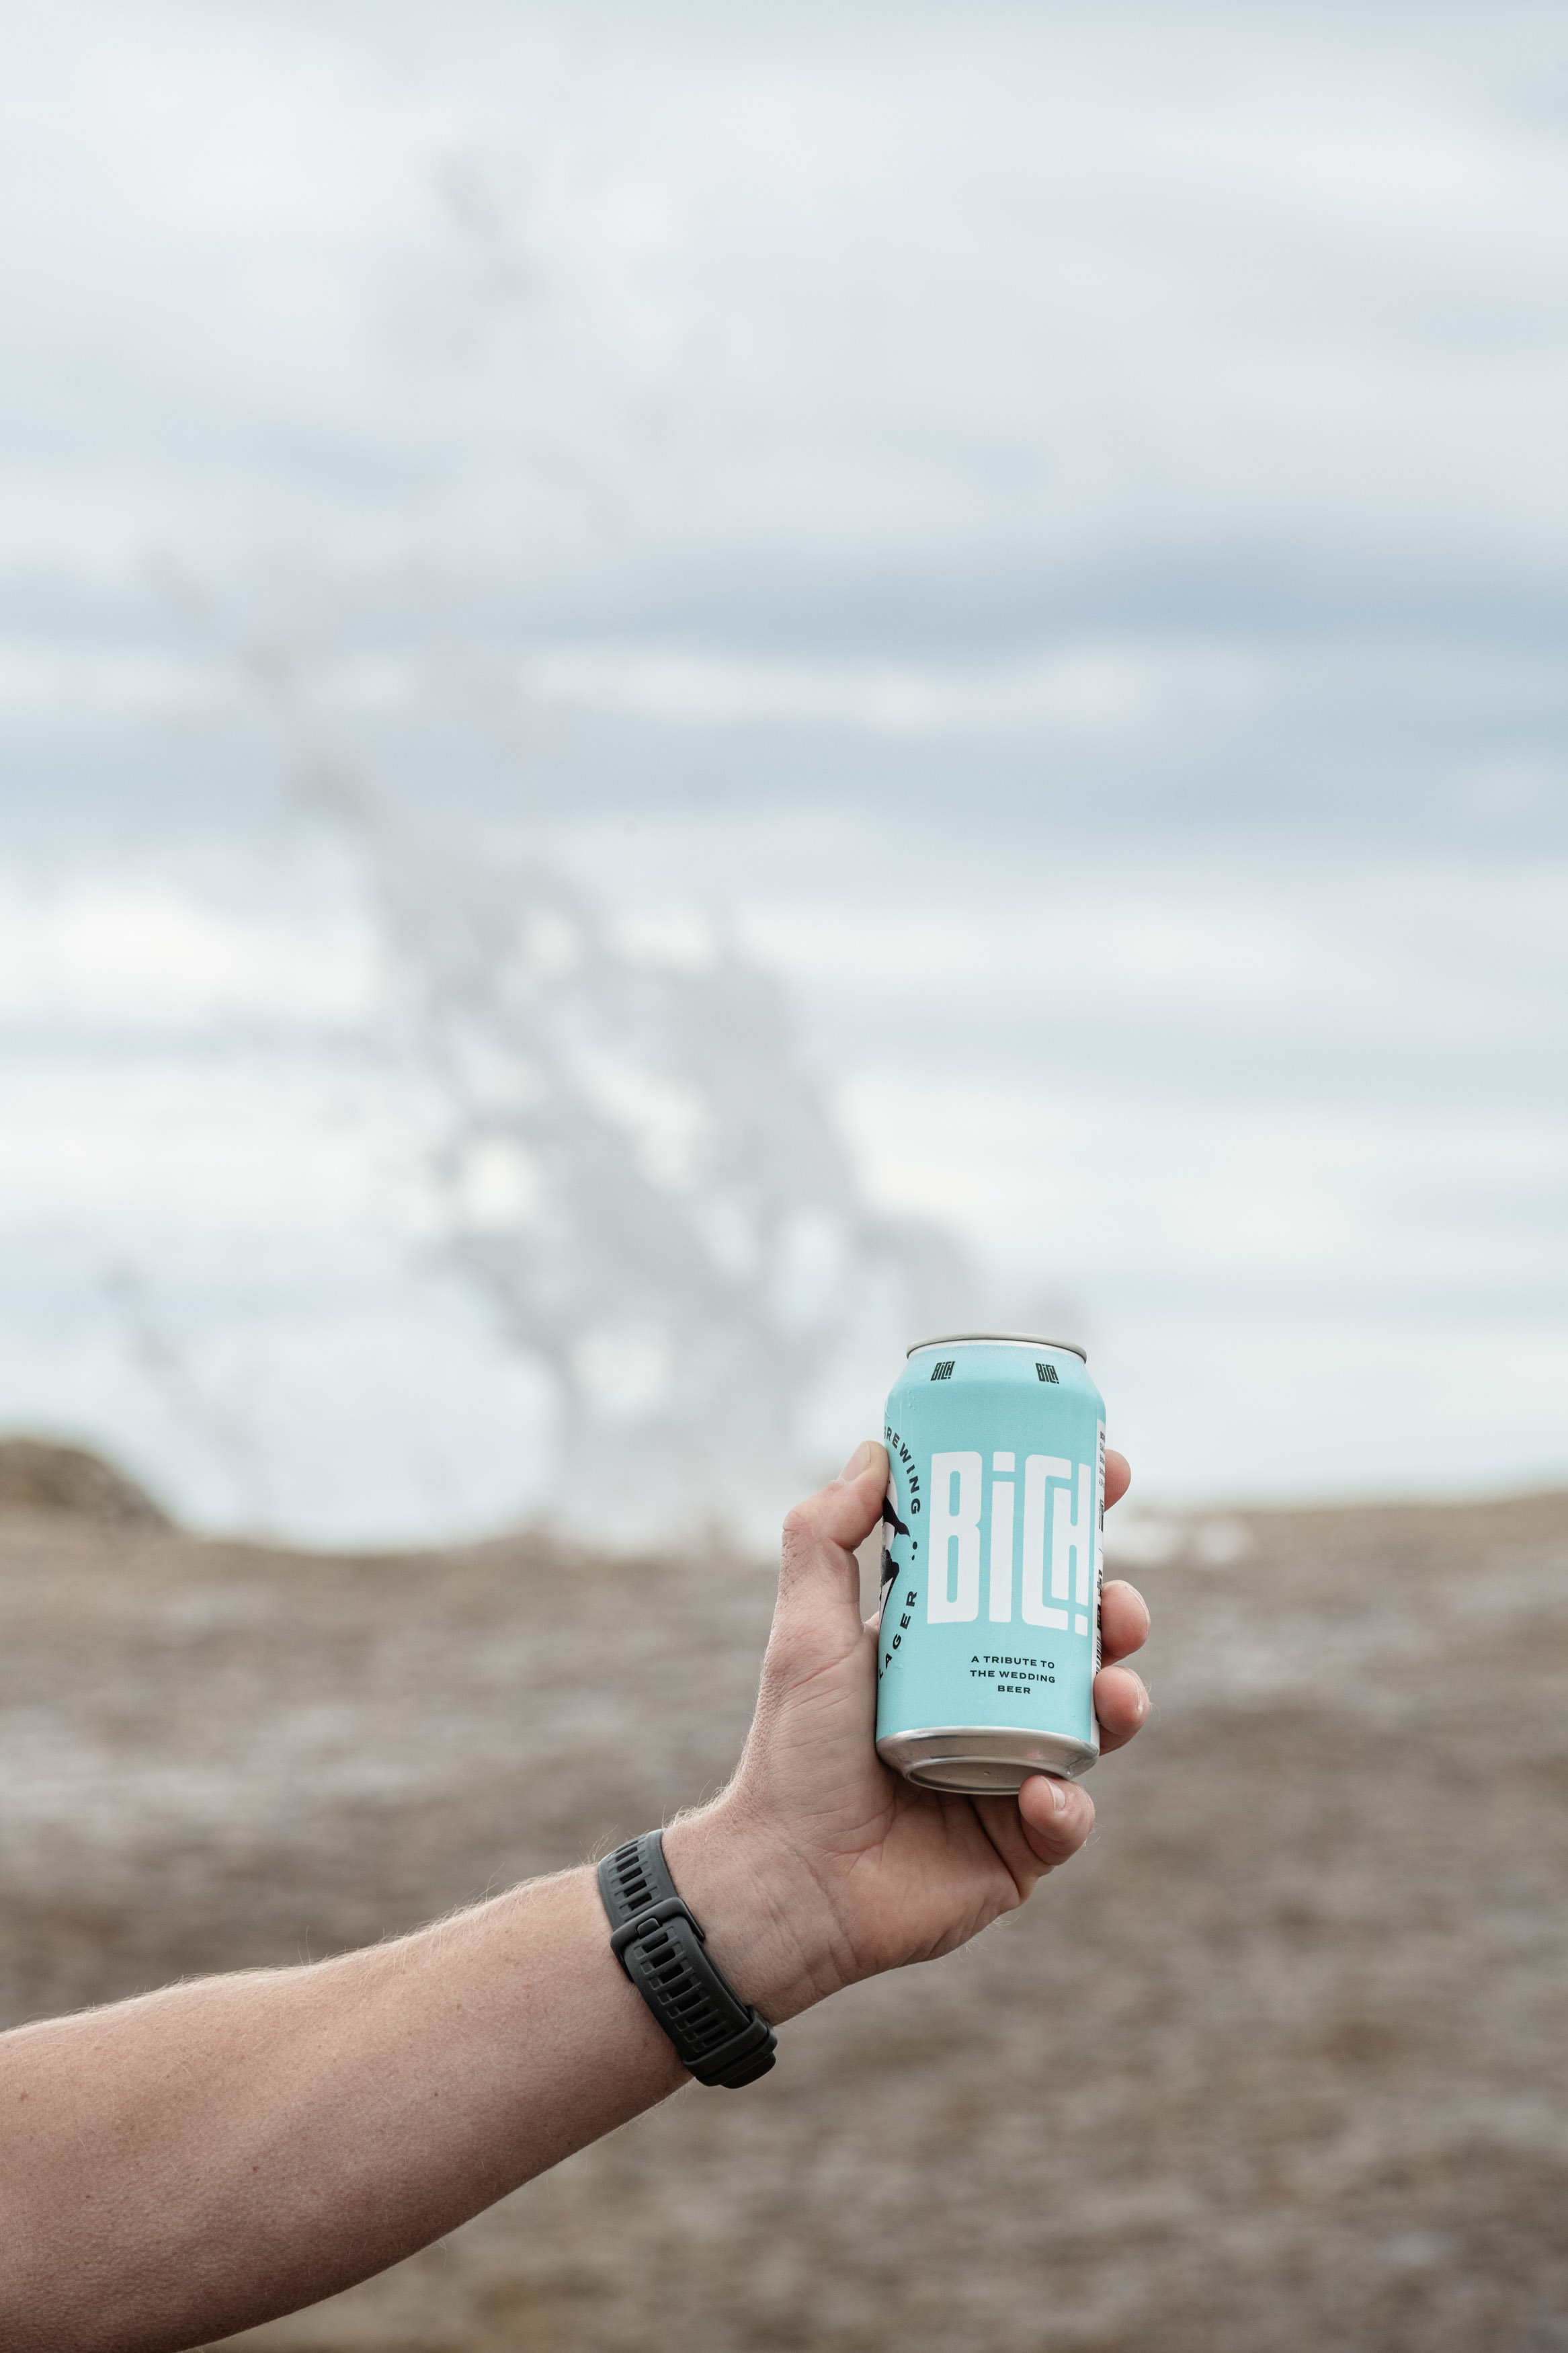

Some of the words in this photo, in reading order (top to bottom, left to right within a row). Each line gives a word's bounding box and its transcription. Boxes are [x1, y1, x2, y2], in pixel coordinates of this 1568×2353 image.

[983, 1656, 1037, 1666] TRIBUTE
[1040, 1661, 1055, 1669] TO
[999, 1671, 1056, 1683] WEDDING
[997, 1685, 1031, 1694] BEER
